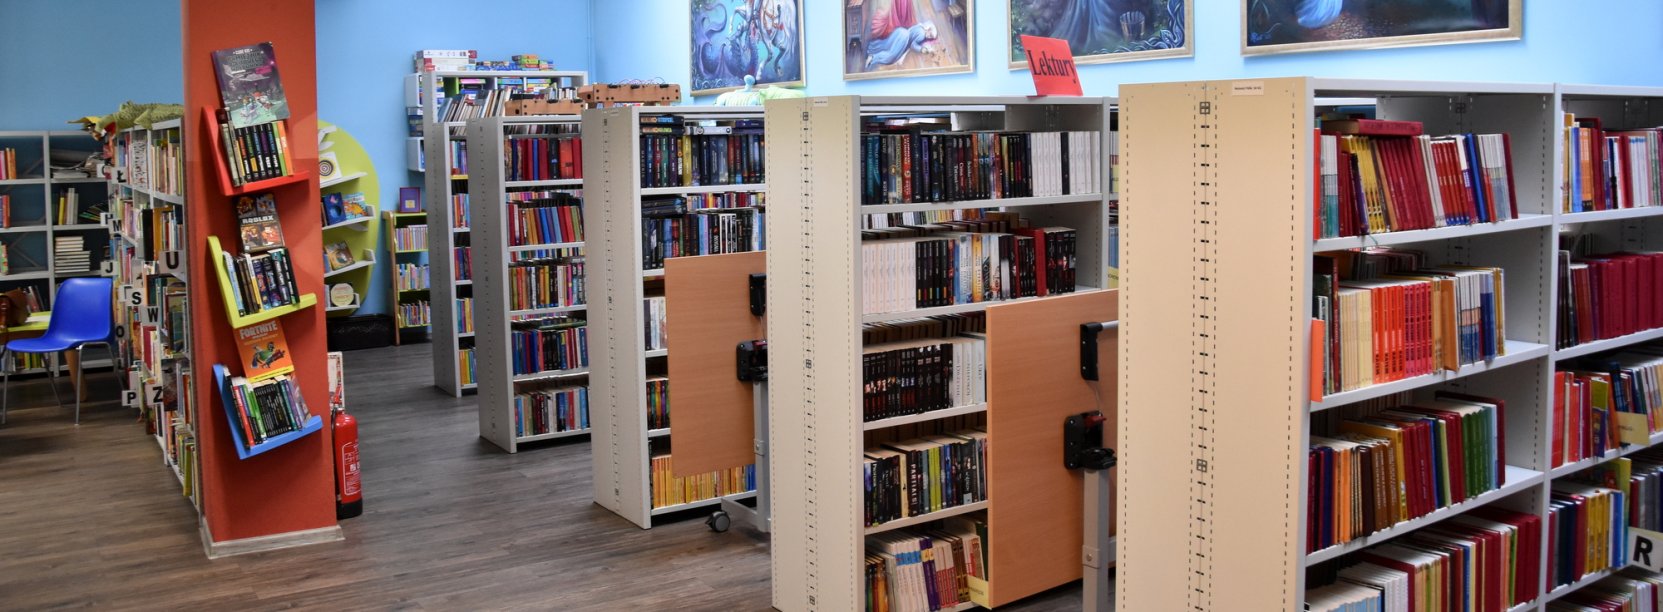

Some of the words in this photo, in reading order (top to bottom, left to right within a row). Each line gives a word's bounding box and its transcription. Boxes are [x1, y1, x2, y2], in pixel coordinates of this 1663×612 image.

[1027, 50, 1076, 84] Lektury
[117, 170, 127, 183] Ł
[242, 215, 274, 224] ROBLOX
[166, 251, 179, 269] U
[105, 262, 113, 273] J
[132, 292, 142, 305] S
[148, 307, 159, 322] W
[116, 325, 125, 338] O
[240, 320, 278, 340] FORTNITE
[127, 392, 136, 405] P
[152, 386, 163, 403] Z
[1633, 535, 1653, 567] R
